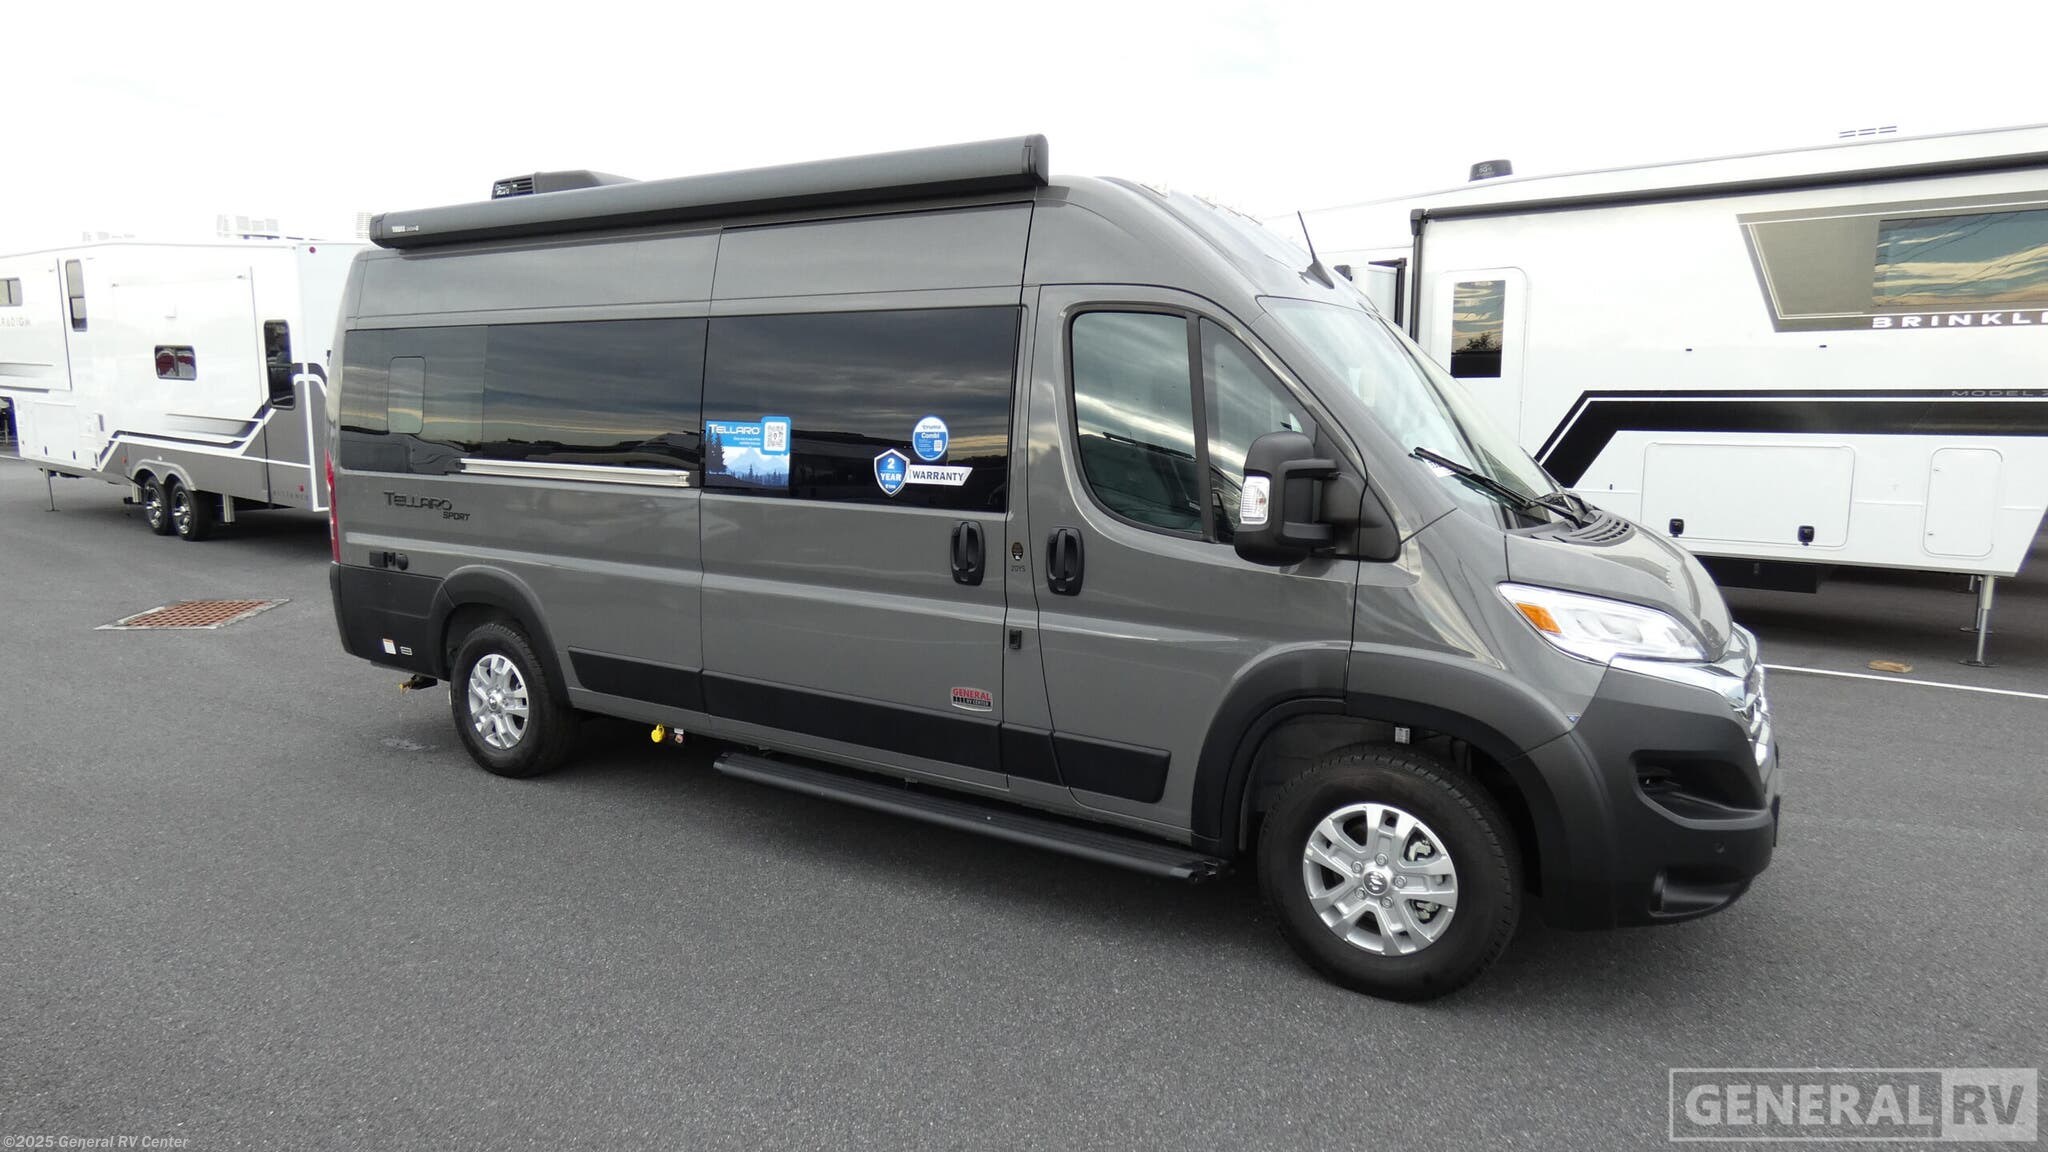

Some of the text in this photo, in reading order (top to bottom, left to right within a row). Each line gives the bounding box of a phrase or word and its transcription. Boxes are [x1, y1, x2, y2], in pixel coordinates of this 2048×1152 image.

[708, 424, 761, 435] TELLARO
[887, 457, 895, 469] 2
[880, 470, 964, 481] YEAR WARRANTY
[383, 492, 453, 511] TELLARO
[442, 511, 471, 521] SPORT
[952, 688, 992, 701] GENERAL
